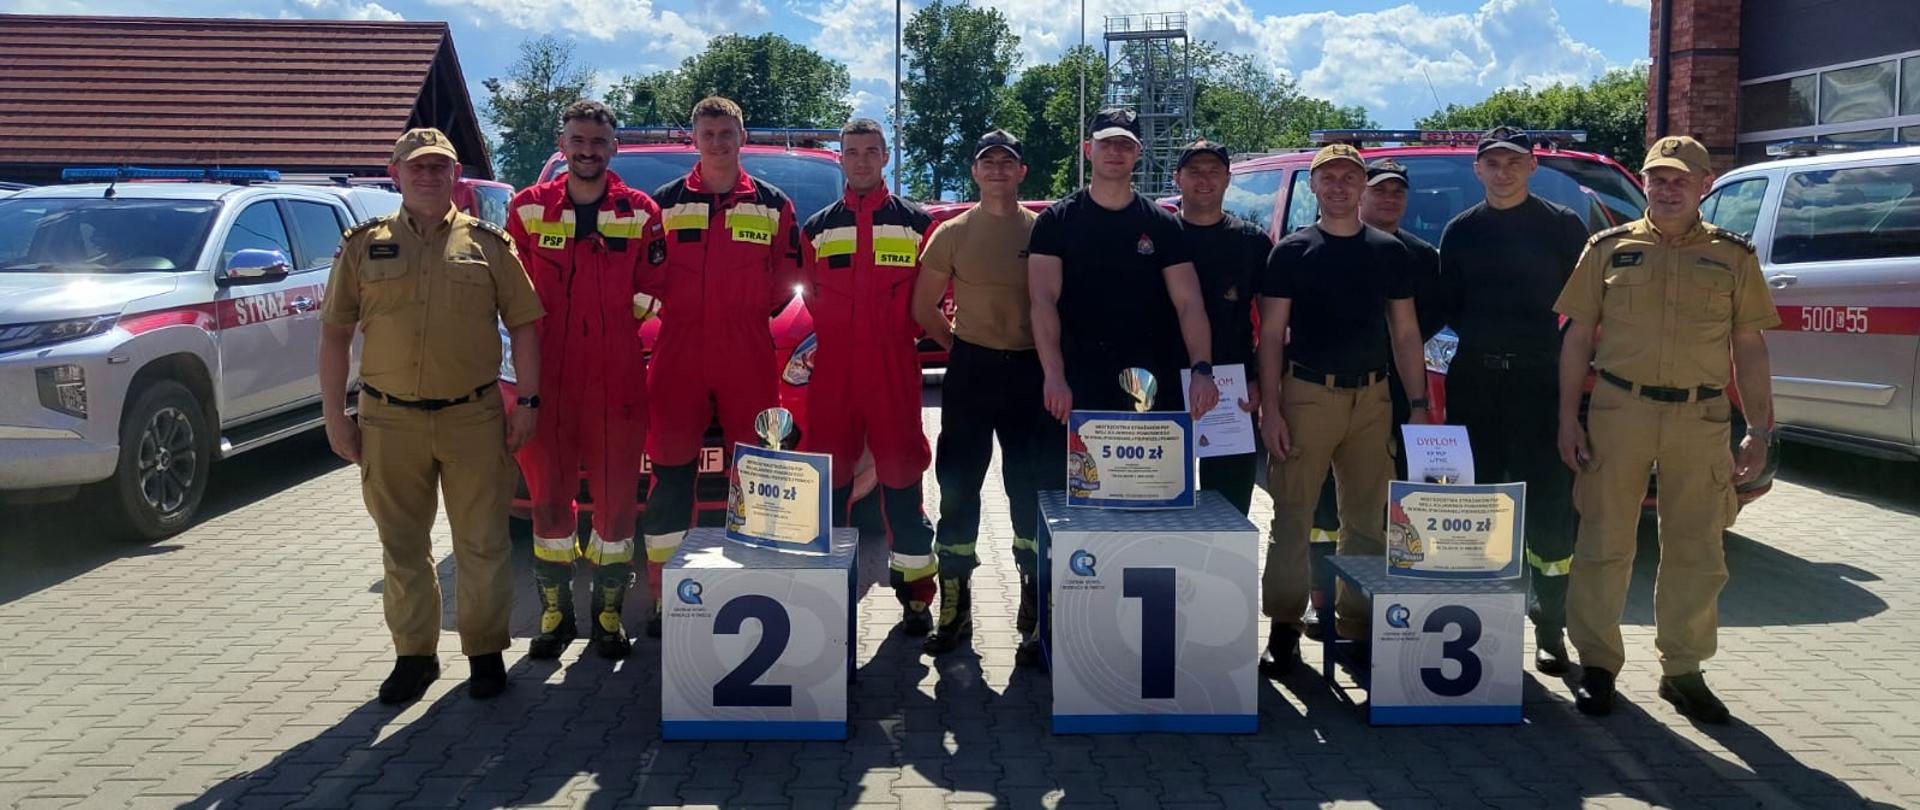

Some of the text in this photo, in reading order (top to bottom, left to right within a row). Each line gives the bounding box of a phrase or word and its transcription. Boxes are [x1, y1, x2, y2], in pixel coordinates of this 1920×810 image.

[543, 235, 563, 246] PSP
[1801, 306, 1834, 332] 500
[1846, 306, 1869, 334] 55
[1417, 437, 1457, 446] DYPLOM
[1102, 445, 1164, 460] 5 000 zł
[748, 481, 797, 500] 3 000 zł
[1426, 517, 1491, 532] 2 000 zł
[1123, 567, 1176, 699] 1
[713, 594, 792, 707] 2
[1420, 604, 1482, 697] 3
